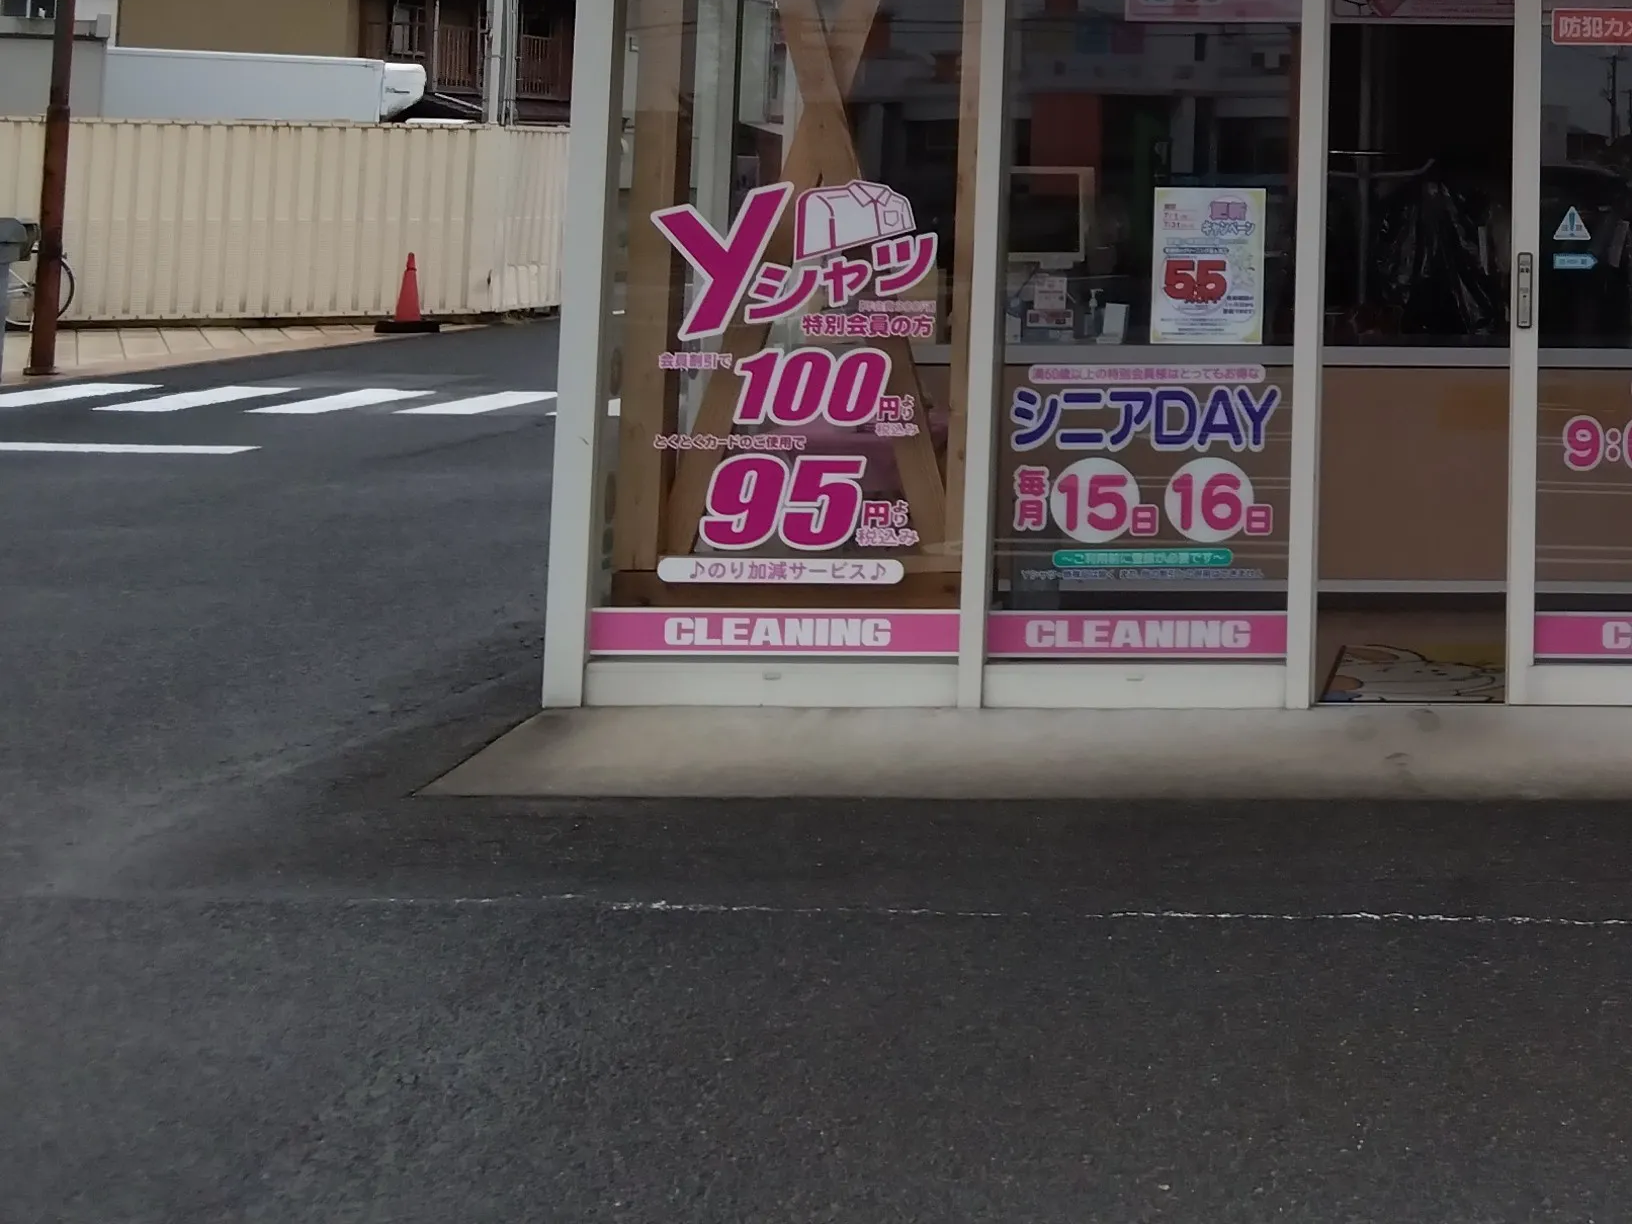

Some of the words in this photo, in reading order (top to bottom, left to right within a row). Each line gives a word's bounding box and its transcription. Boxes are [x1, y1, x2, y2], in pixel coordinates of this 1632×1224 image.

[801, 312, 936, 338] 特別会員の方
[1011, 385, 1282, 453] シニアDAY
[653, 432, 807, 451] とくとくカードのご使用で
[1013, 464, 1050, 533] 毎月
[664, 617, 892, 648] CLEANING
[1025, 619, 1252, 650] CLEANING
